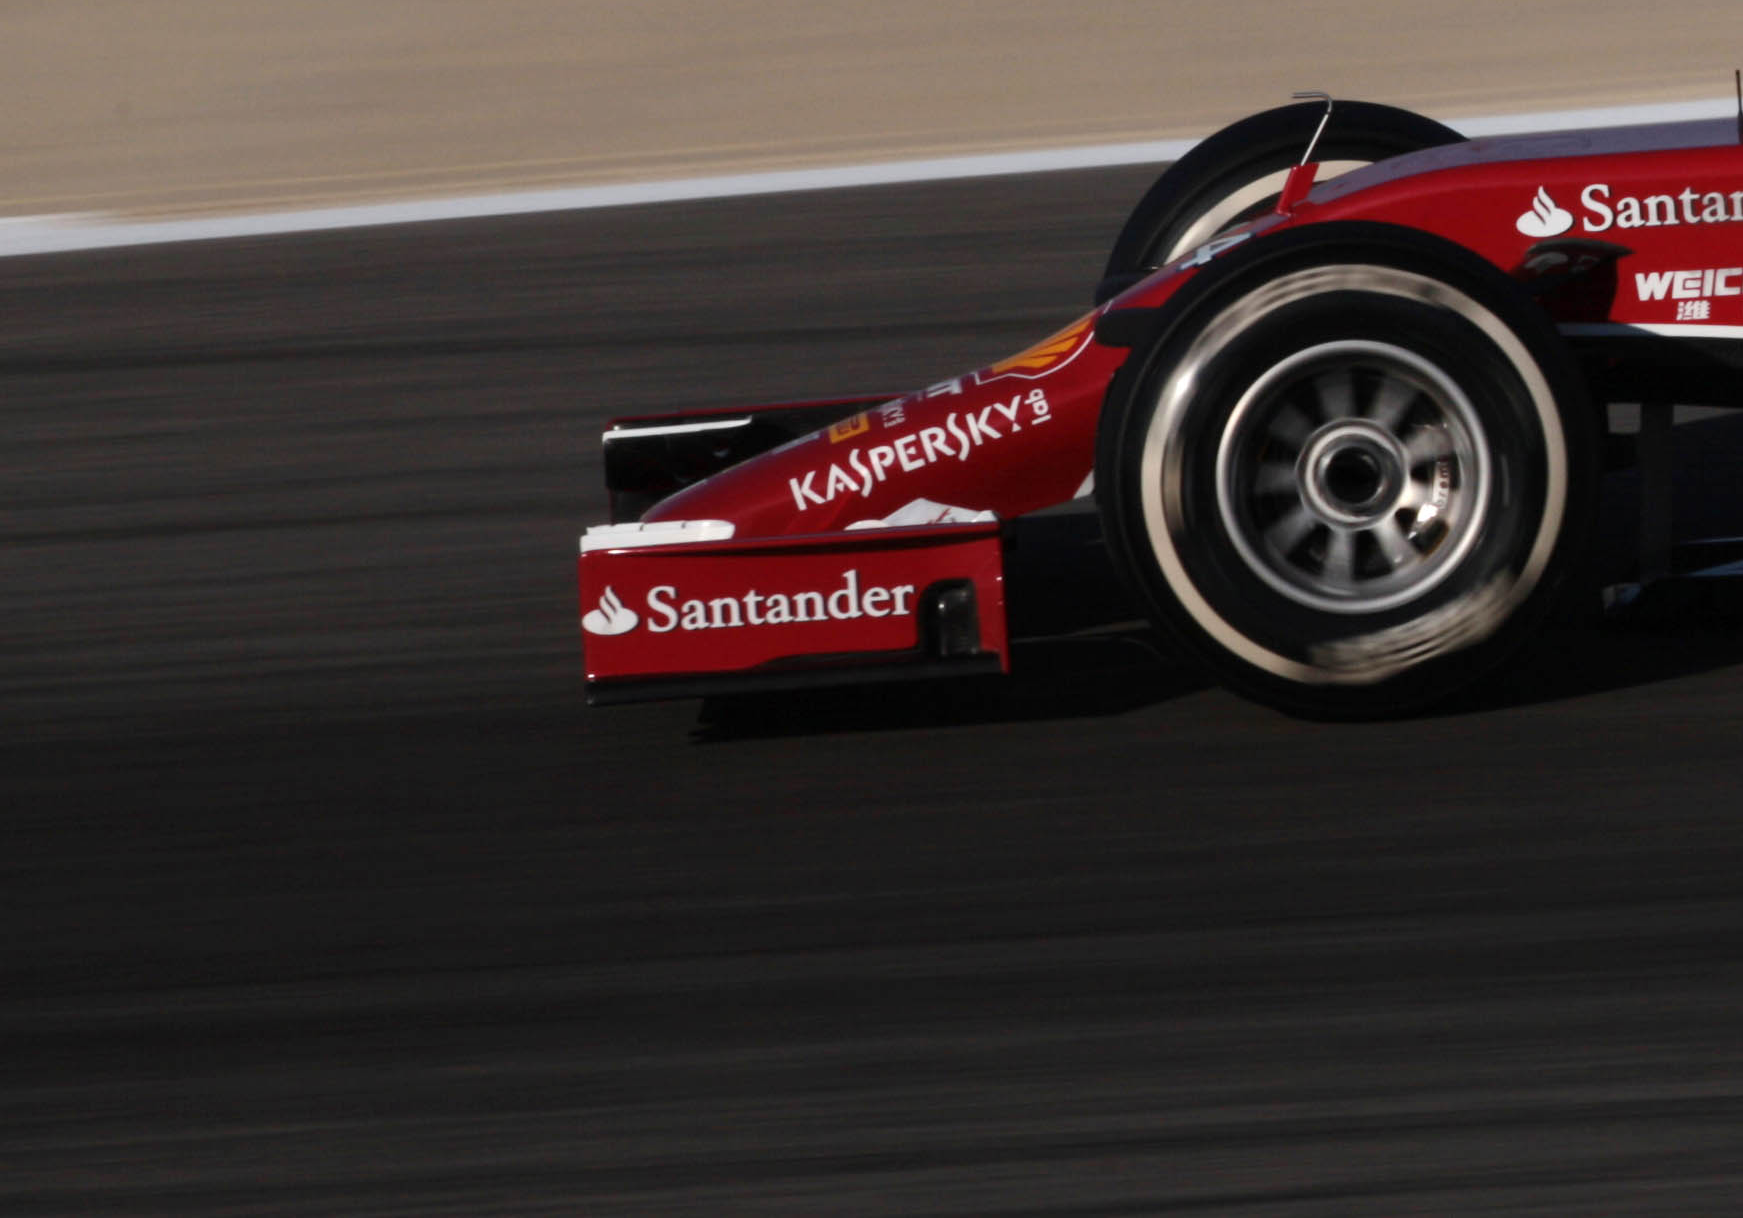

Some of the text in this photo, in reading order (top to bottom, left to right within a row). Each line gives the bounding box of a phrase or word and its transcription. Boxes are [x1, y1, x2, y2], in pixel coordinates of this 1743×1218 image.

[788, 394, 1022, 511] KASPERSKY
[1024, 388, 1052, 425] lab
[647, 569, 915, 633] Santander
